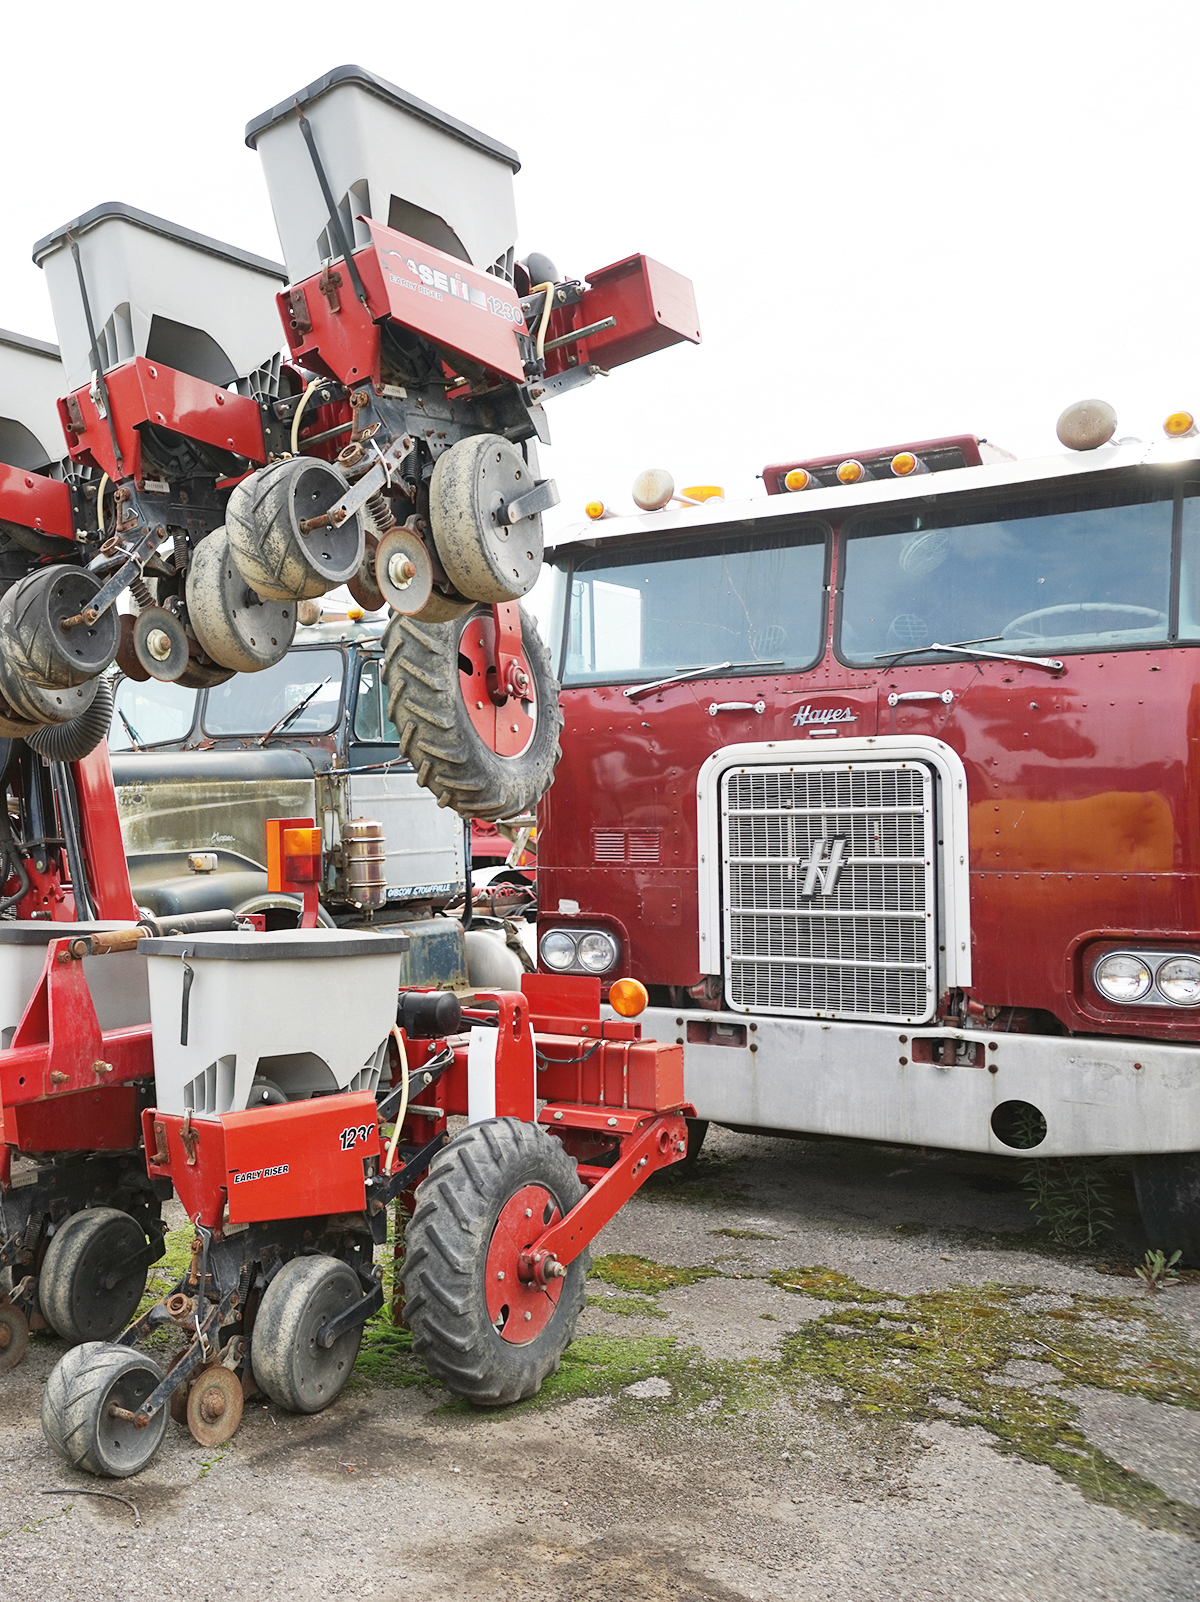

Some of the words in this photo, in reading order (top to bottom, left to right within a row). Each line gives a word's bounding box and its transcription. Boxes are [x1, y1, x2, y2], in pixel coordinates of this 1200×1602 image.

[389, 274, 417, 291] EARLY
[417, 286, 444, 302] RISER
[488, 296, 524, 326] 1230
[791, 705, 858, 727] Hayes
[387, 888, 412, 897] GIBSON
[413, 884, 451, 895] STOUFFVILLE
[234, 1169, 263, 1184] EARLY
[263, 1164, 290, 1179] RISER
